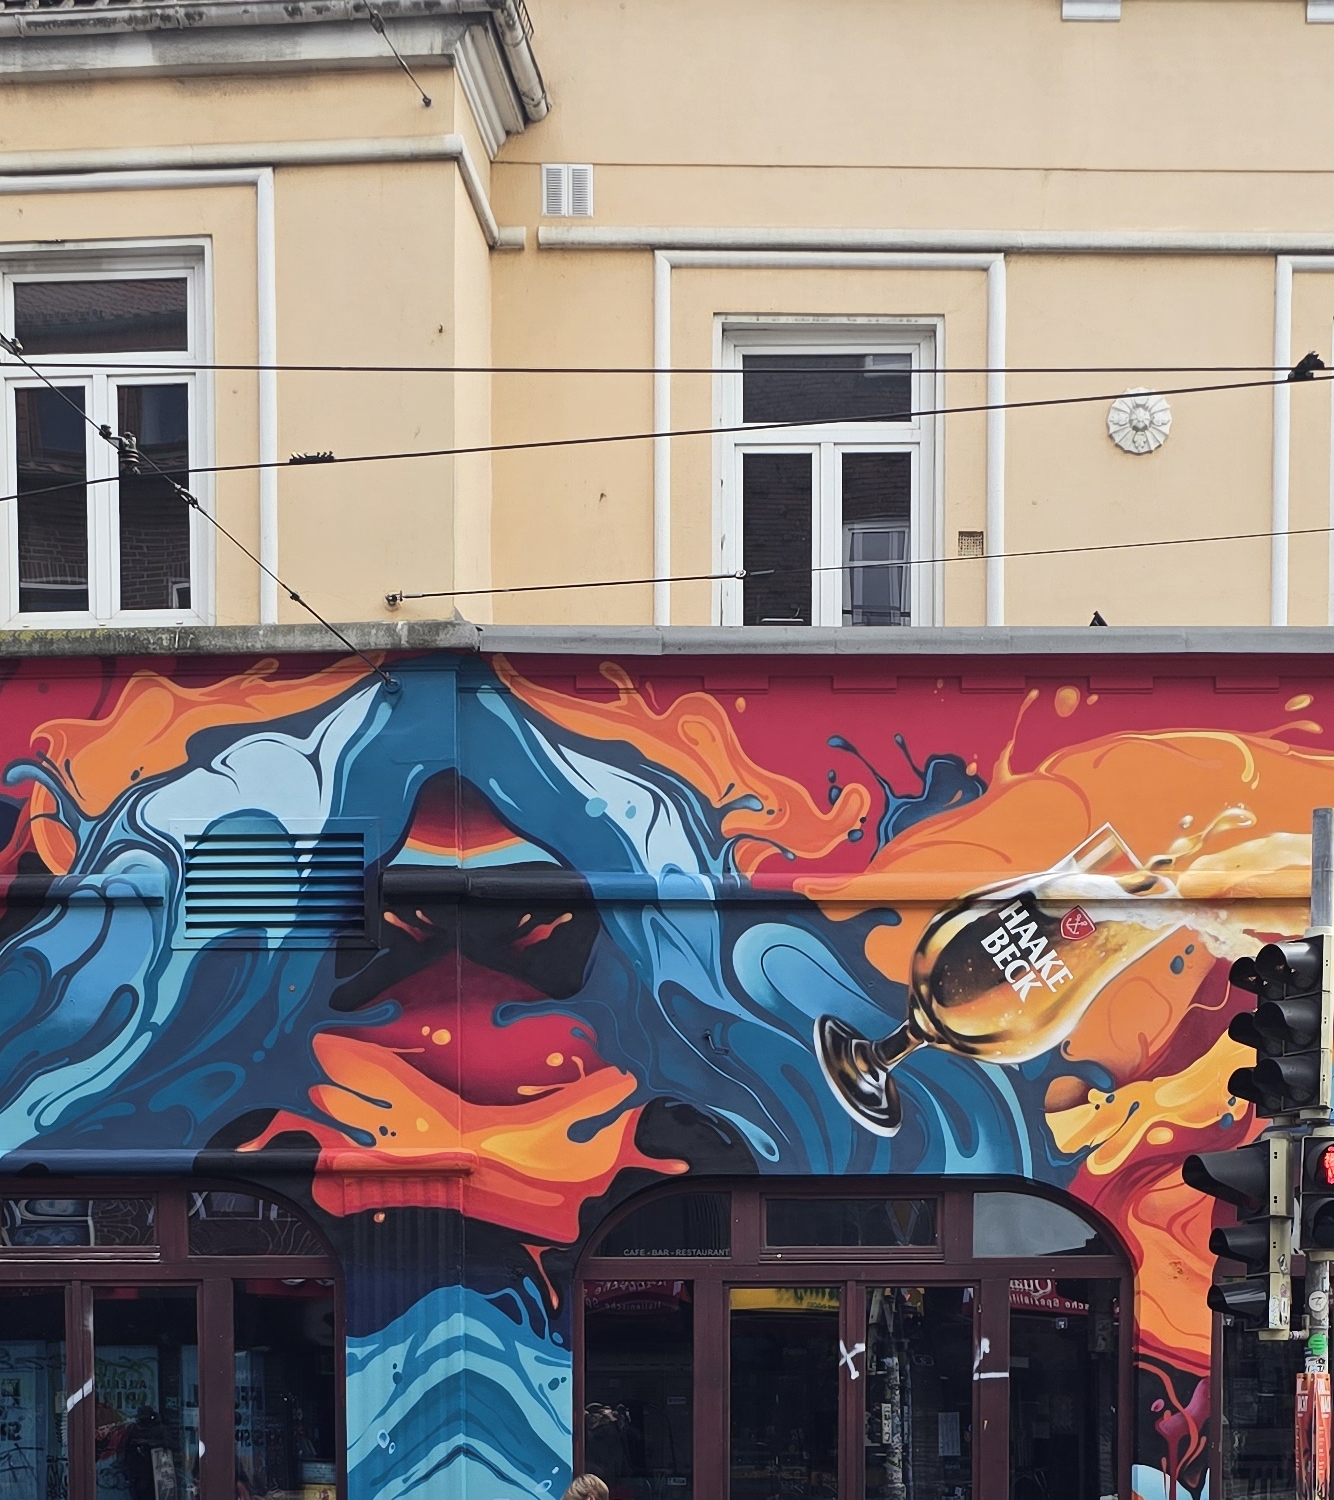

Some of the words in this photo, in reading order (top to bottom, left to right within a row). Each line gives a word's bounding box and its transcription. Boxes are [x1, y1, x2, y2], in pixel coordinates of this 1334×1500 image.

[981, 927, 1043, 1003] BECK
[998, 900, 1074, 993] HAAKE
[623, 1248, 646, 1256] CAFE
[651, 1248, 670, 1256] BAR
[675, 1247, 730, 1256] RESTAURANT
